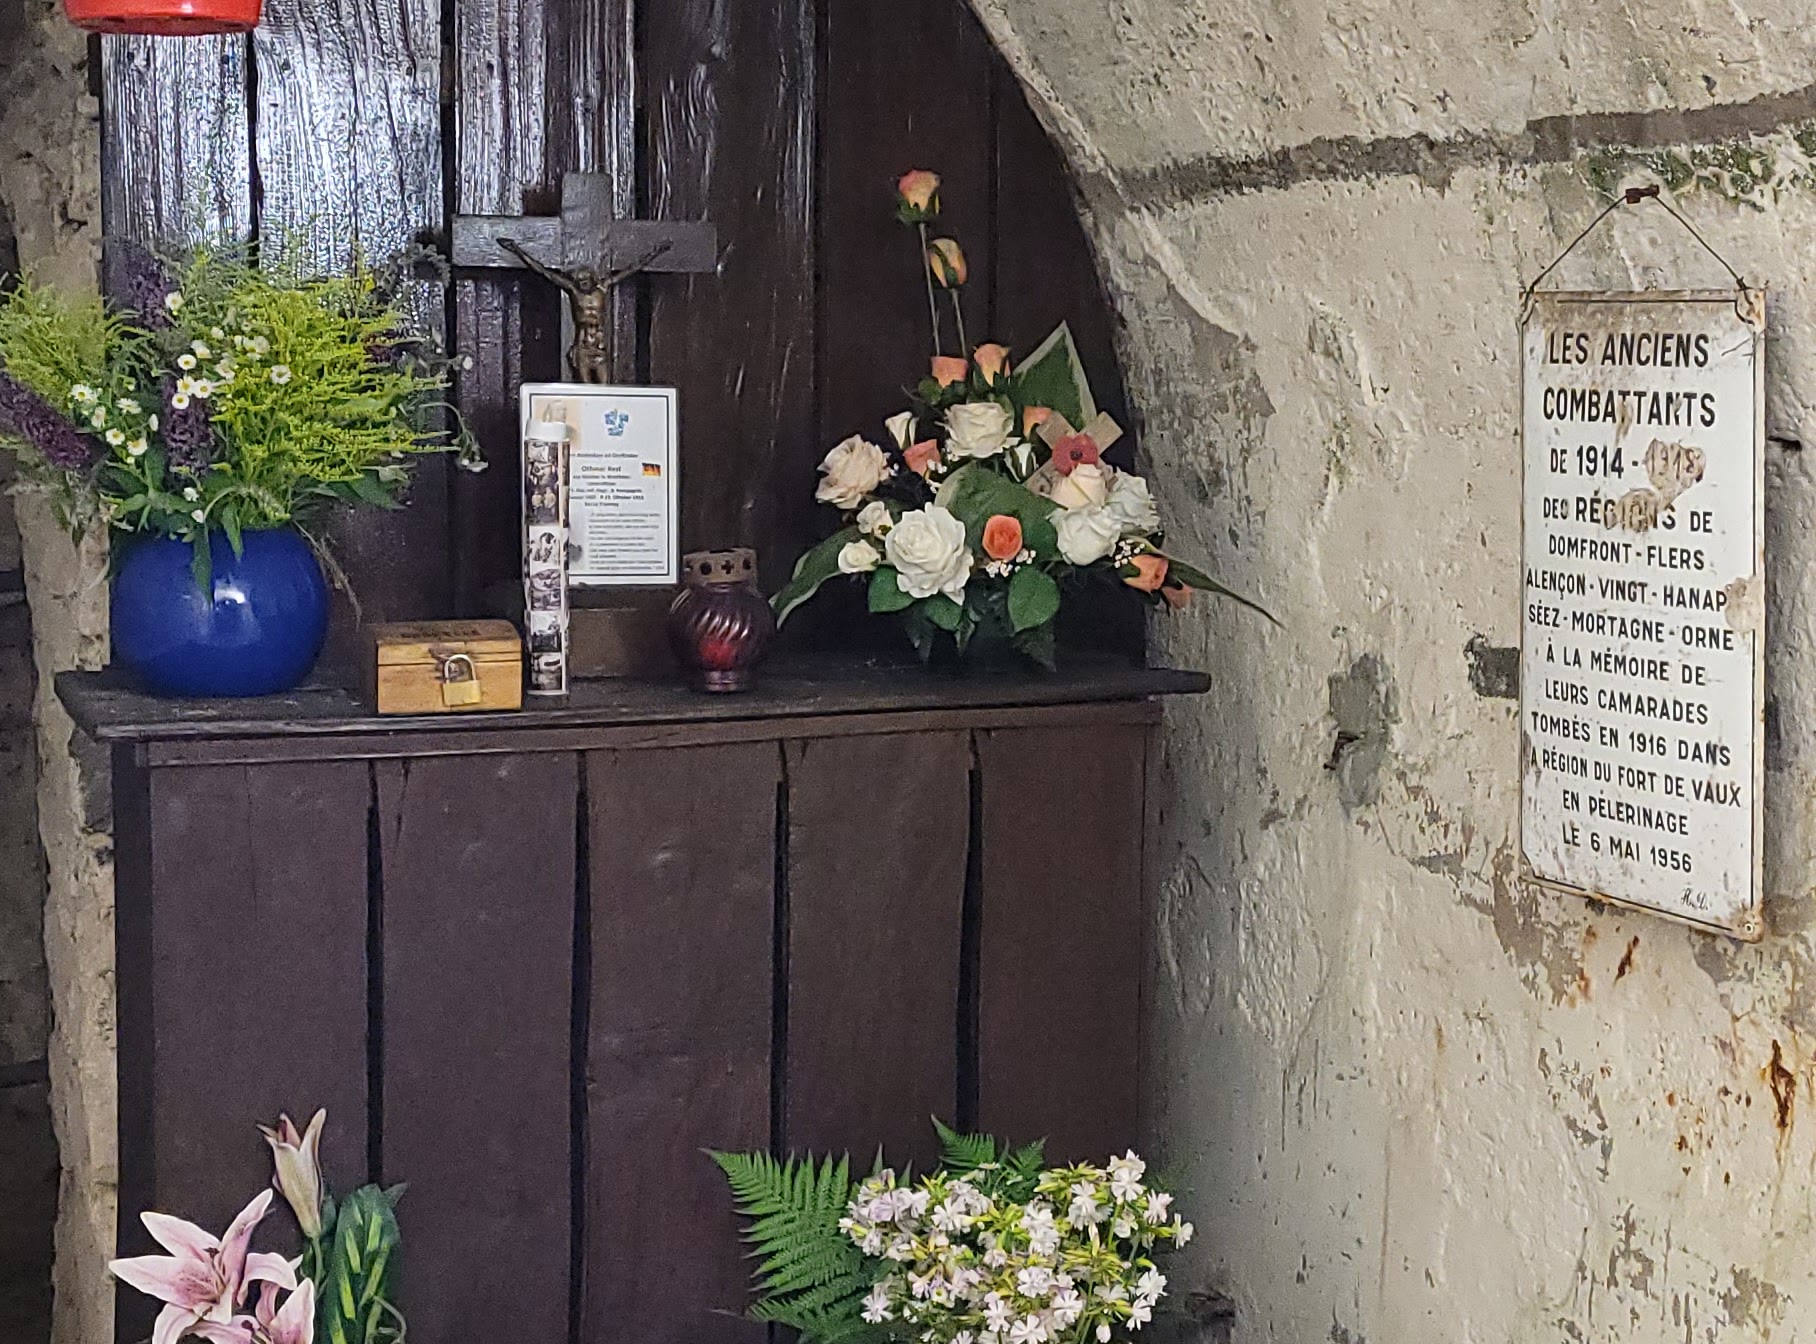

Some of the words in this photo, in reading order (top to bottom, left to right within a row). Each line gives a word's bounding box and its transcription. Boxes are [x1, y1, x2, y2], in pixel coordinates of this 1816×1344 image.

[1550, 332, 1589, 365] LES
[1600, 332, 1710, 368] ANCIENS
[1542, 388, 1716, 428] COMBATTANTS
[1550, 448, 1568, 475] DE
[1576, 445, 1624, 479] 1914
[1543, 496, 1569, 520] DES
[1690, 510, 1713, 534] DE
[1549, 534, 1632, 564] DOMFRONT
[1647, 545, 1705, 570] FLERS
[1526, 567, 1586, 600] ALENÇON
[1598, 576, 1648, 605] VINGT
[1663, 584, 1728, 612] HANAP
[1528, 602, 1560, 628] SÉEZ
[1572, 611, 1664, 643] MORTAGNE
[1682, 625, 1735, 652] ORNE
[1546, 637, 1556, 664] À
[1564, 646, 1582, 669] LA
[1590, 648, 1670, 682] MÉMOIRE
[1682, 664, 1706, 687] DE
[1545, 678, 1589, 705] LEURS
[1598, 688, 1709, 725] CAMARADES
[1531, 711, 1590, 743] TOMBÉS
[1600, 726, 1620, 749] EN
[1629, 730, 1667, 756] 1916
[1678, 739, 1731, 767] DANS
[1543, 743, 1588, 778] RÉGION
[1594, 760, 1612, 781] DU
[1618, 766, 1656, 792] FORT
[1664, 774, 1685, 797] DE
[1692, 779, 1742, 807] VAUX
[1562, 789, 1580, 812] EN
[1589, 790, 1689, 836] PÉLERINAGE
[1563, 824, 1580, 847] LE
[1590, 832, 1600, 852] 6
[1610, 836, 1640, 862] MAI
[1650, 846, 1692, 873] 1956
